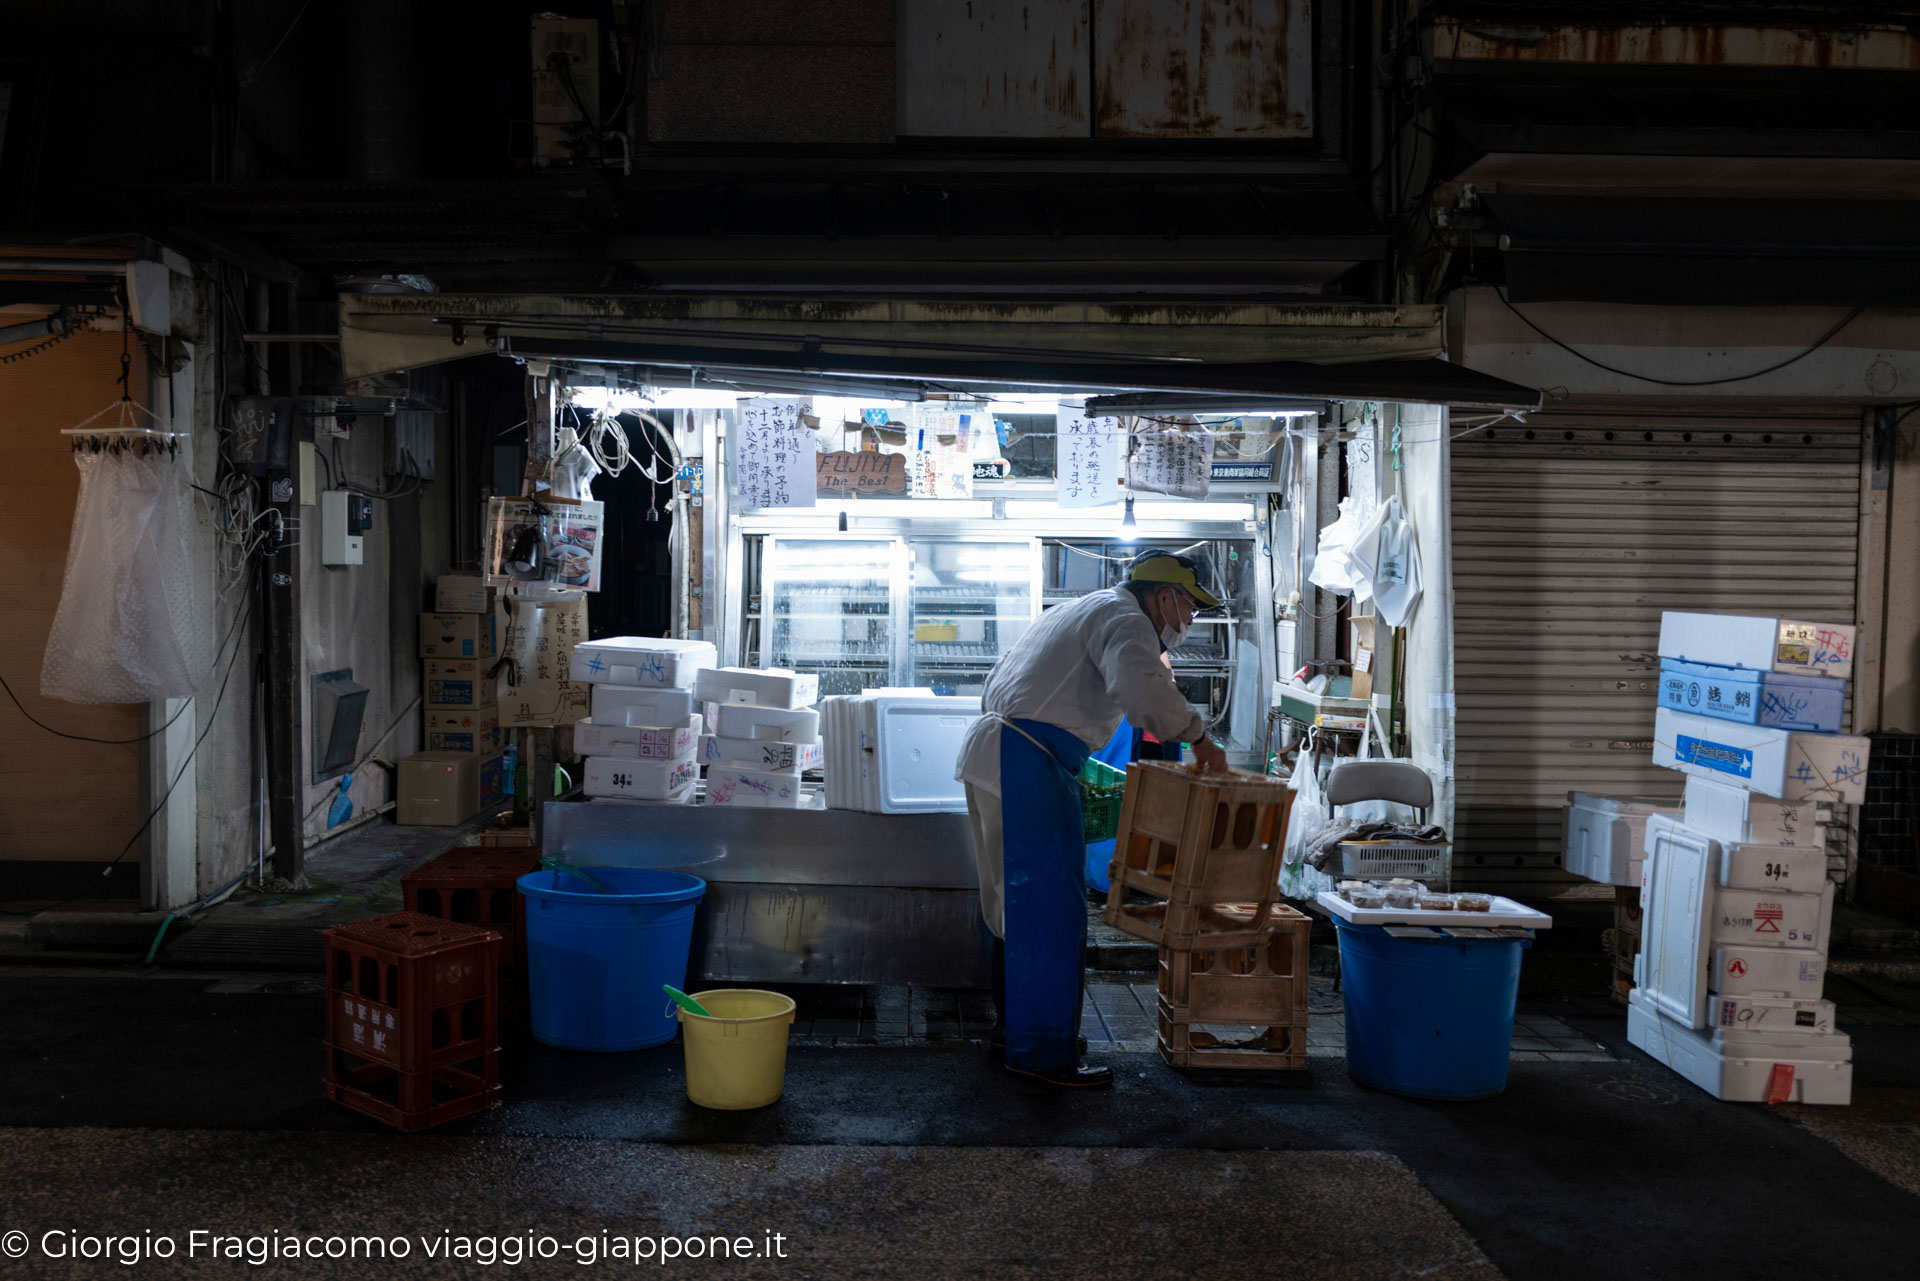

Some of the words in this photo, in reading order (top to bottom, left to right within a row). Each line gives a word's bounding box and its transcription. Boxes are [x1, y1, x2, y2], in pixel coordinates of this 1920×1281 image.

[802, 403, 813, 439] 今も
[771, 405, 790, 505] お節料理の予約
[818, 456, 892, 473] FUJIYA
[825, 475, 847, 486] The
[857, 475, 889, 486] Best
[1788, 929, 1798, 940] 5
[1803, 932, 1812, 942] kg
